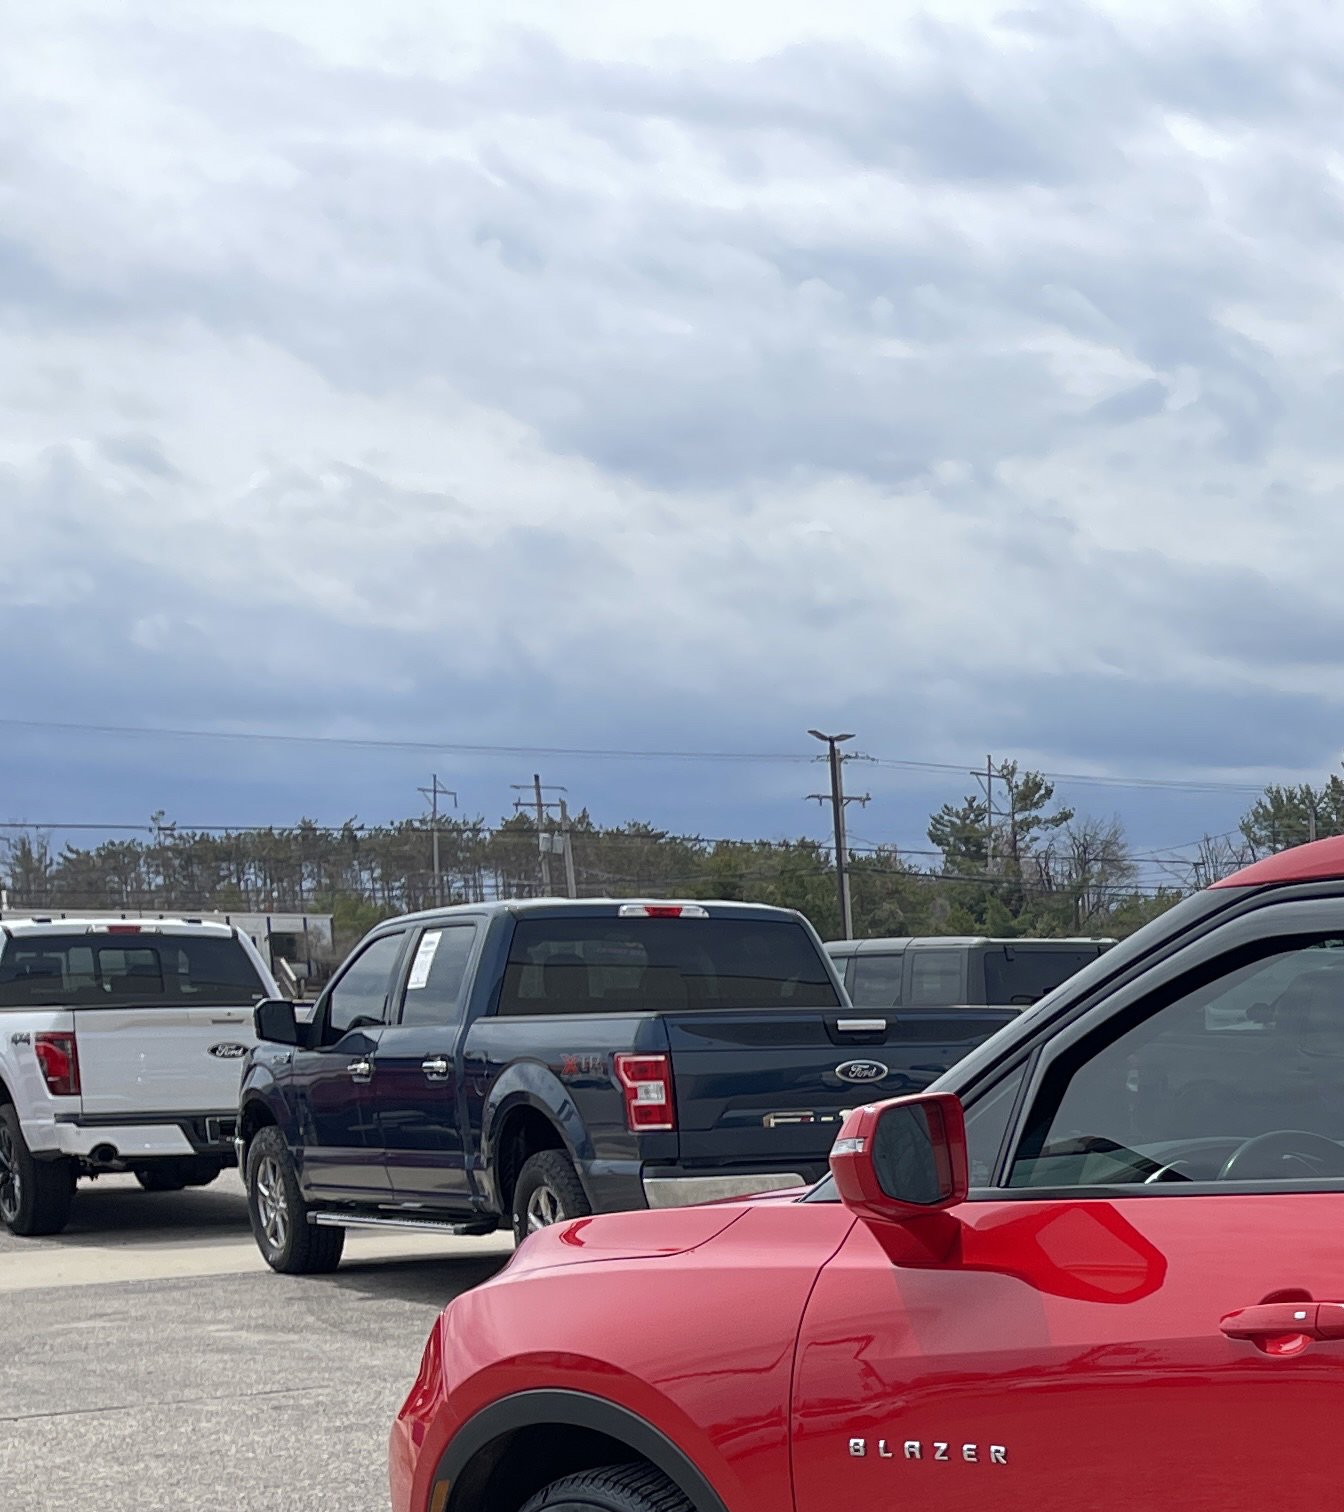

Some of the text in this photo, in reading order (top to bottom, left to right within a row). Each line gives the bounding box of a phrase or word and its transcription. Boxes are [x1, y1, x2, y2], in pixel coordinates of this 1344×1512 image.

[215, 1044, 244, 1057] Ford
[848, 1063, 877, 1079] Ford
[848, 1437, 1008, 1465] BLAZER
